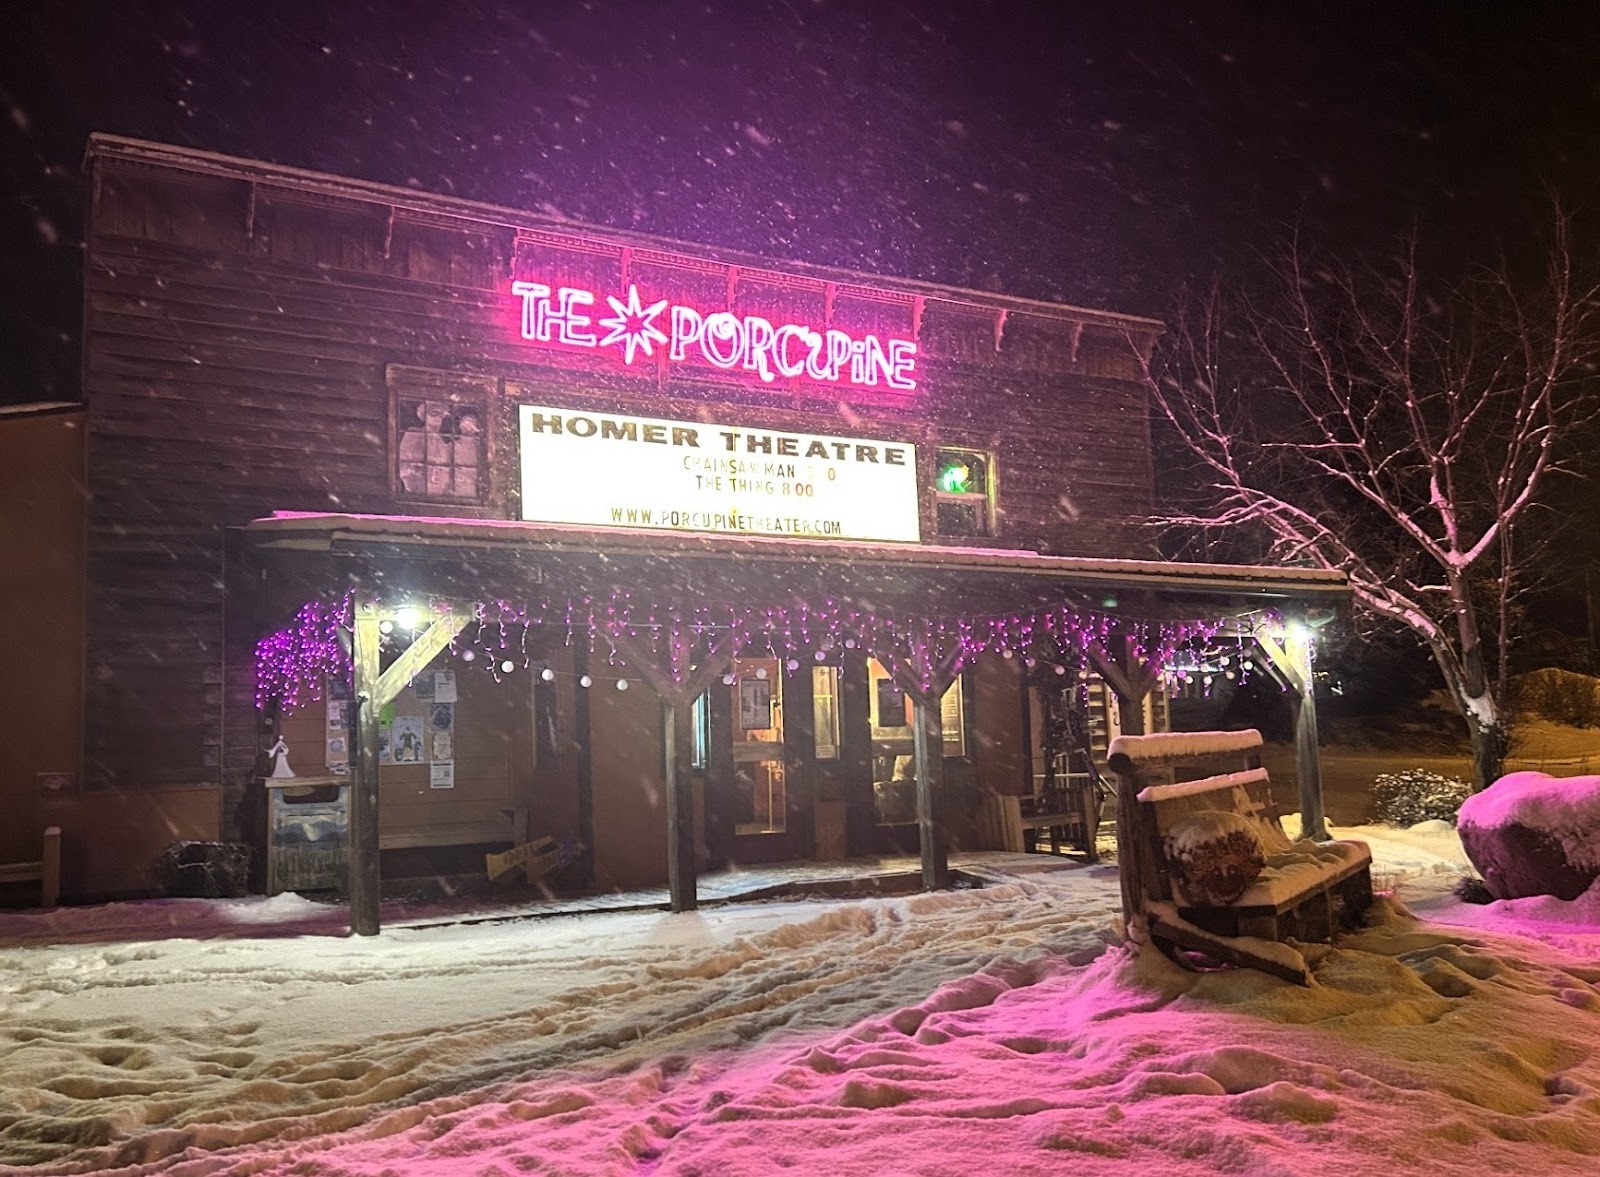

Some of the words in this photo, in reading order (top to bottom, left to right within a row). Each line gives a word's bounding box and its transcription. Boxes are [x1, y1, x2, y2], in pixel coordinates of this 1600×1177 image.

[512, 281, 597, 346] THE
[532, 413, 700, 447] HOMER
[720, 432, 906, 466] THEATRE
[695, 475, 722, 490] THE
[729, 478, 774, 494] THING
[765, 462, 795, 478] MAN
